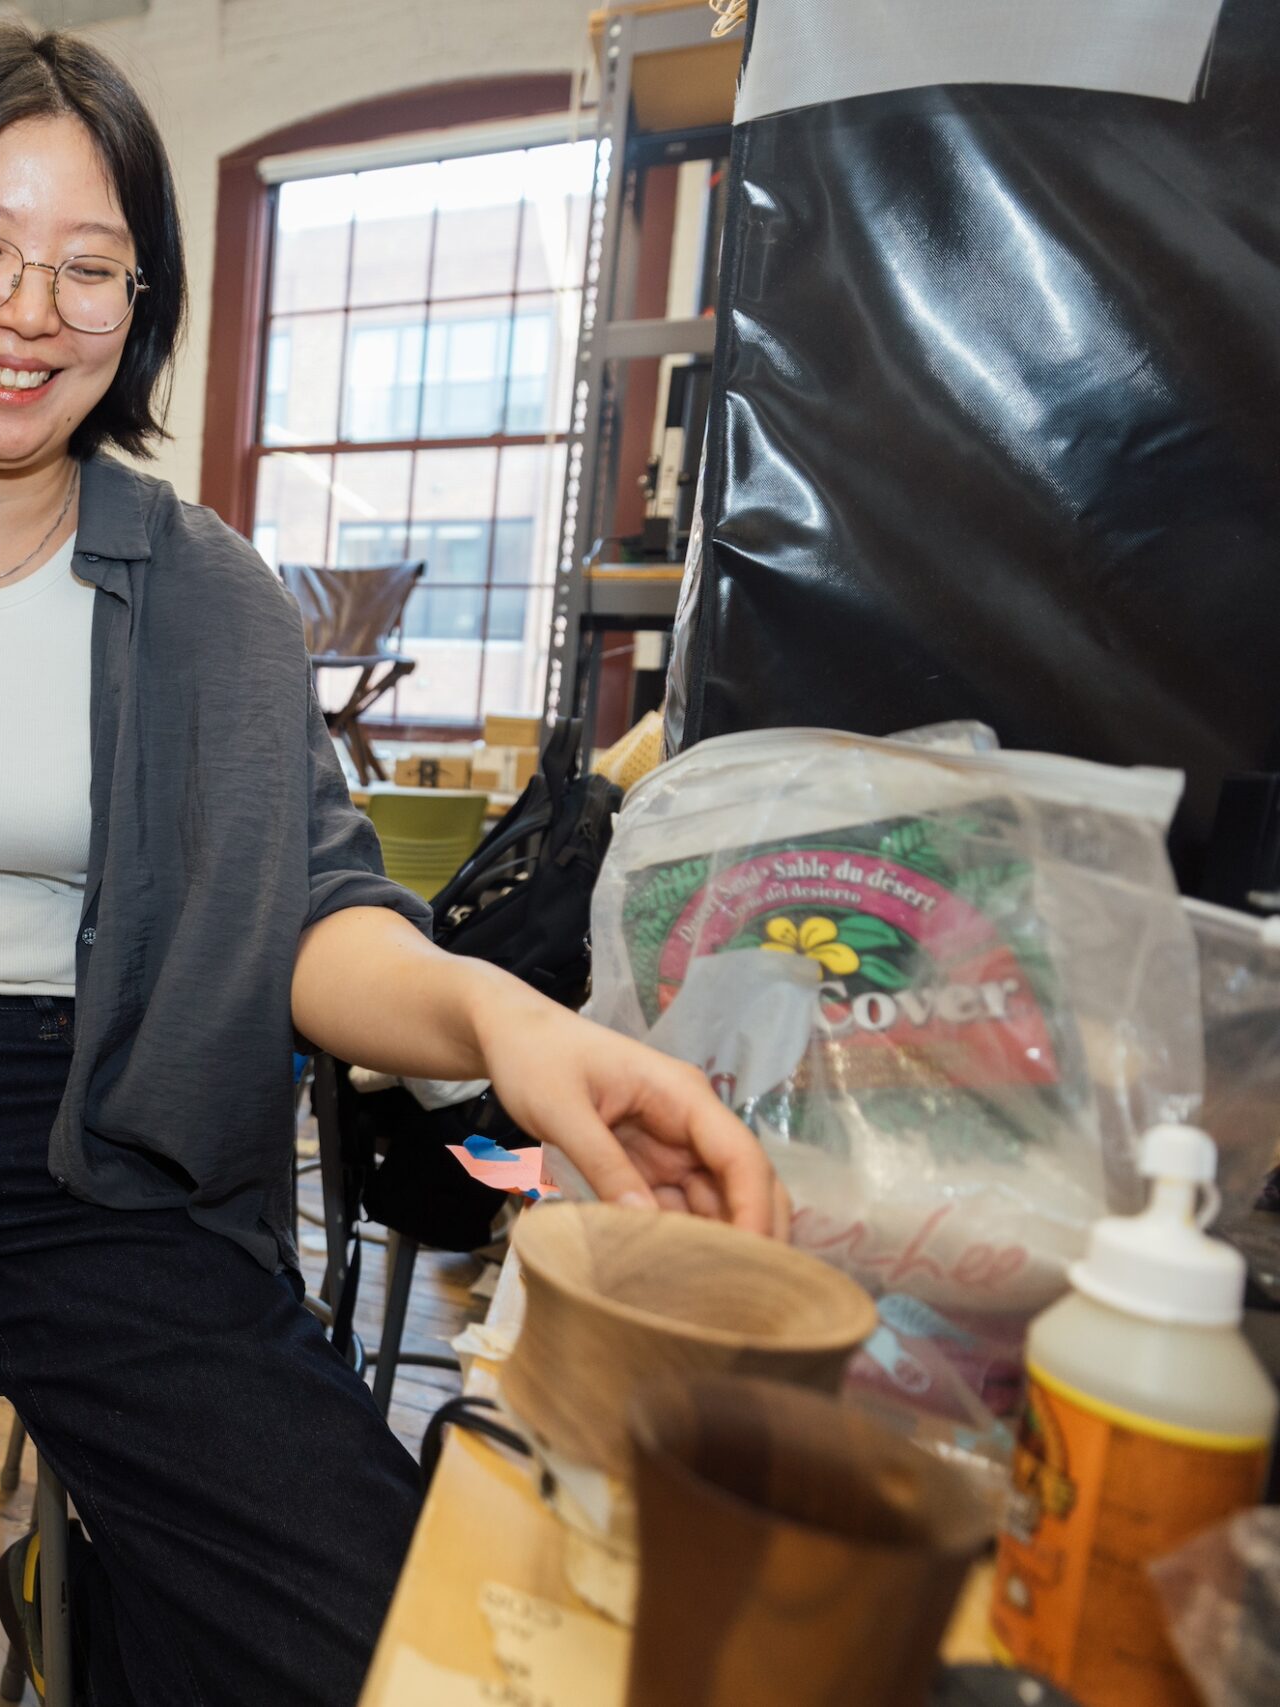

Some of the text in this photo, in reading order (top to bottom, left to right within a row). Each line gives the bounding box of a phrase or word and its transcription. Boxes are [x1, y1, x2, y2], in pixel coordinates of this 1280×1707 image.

[765, 883, 789, 903] del
[791, 883, 862, 905] desierto
[773, 857, 830, 881] Sable
[833, 859, 863, 883] du
[867, 868, 937, 914] désert
[812, 979, 1020, 1033] Cover
